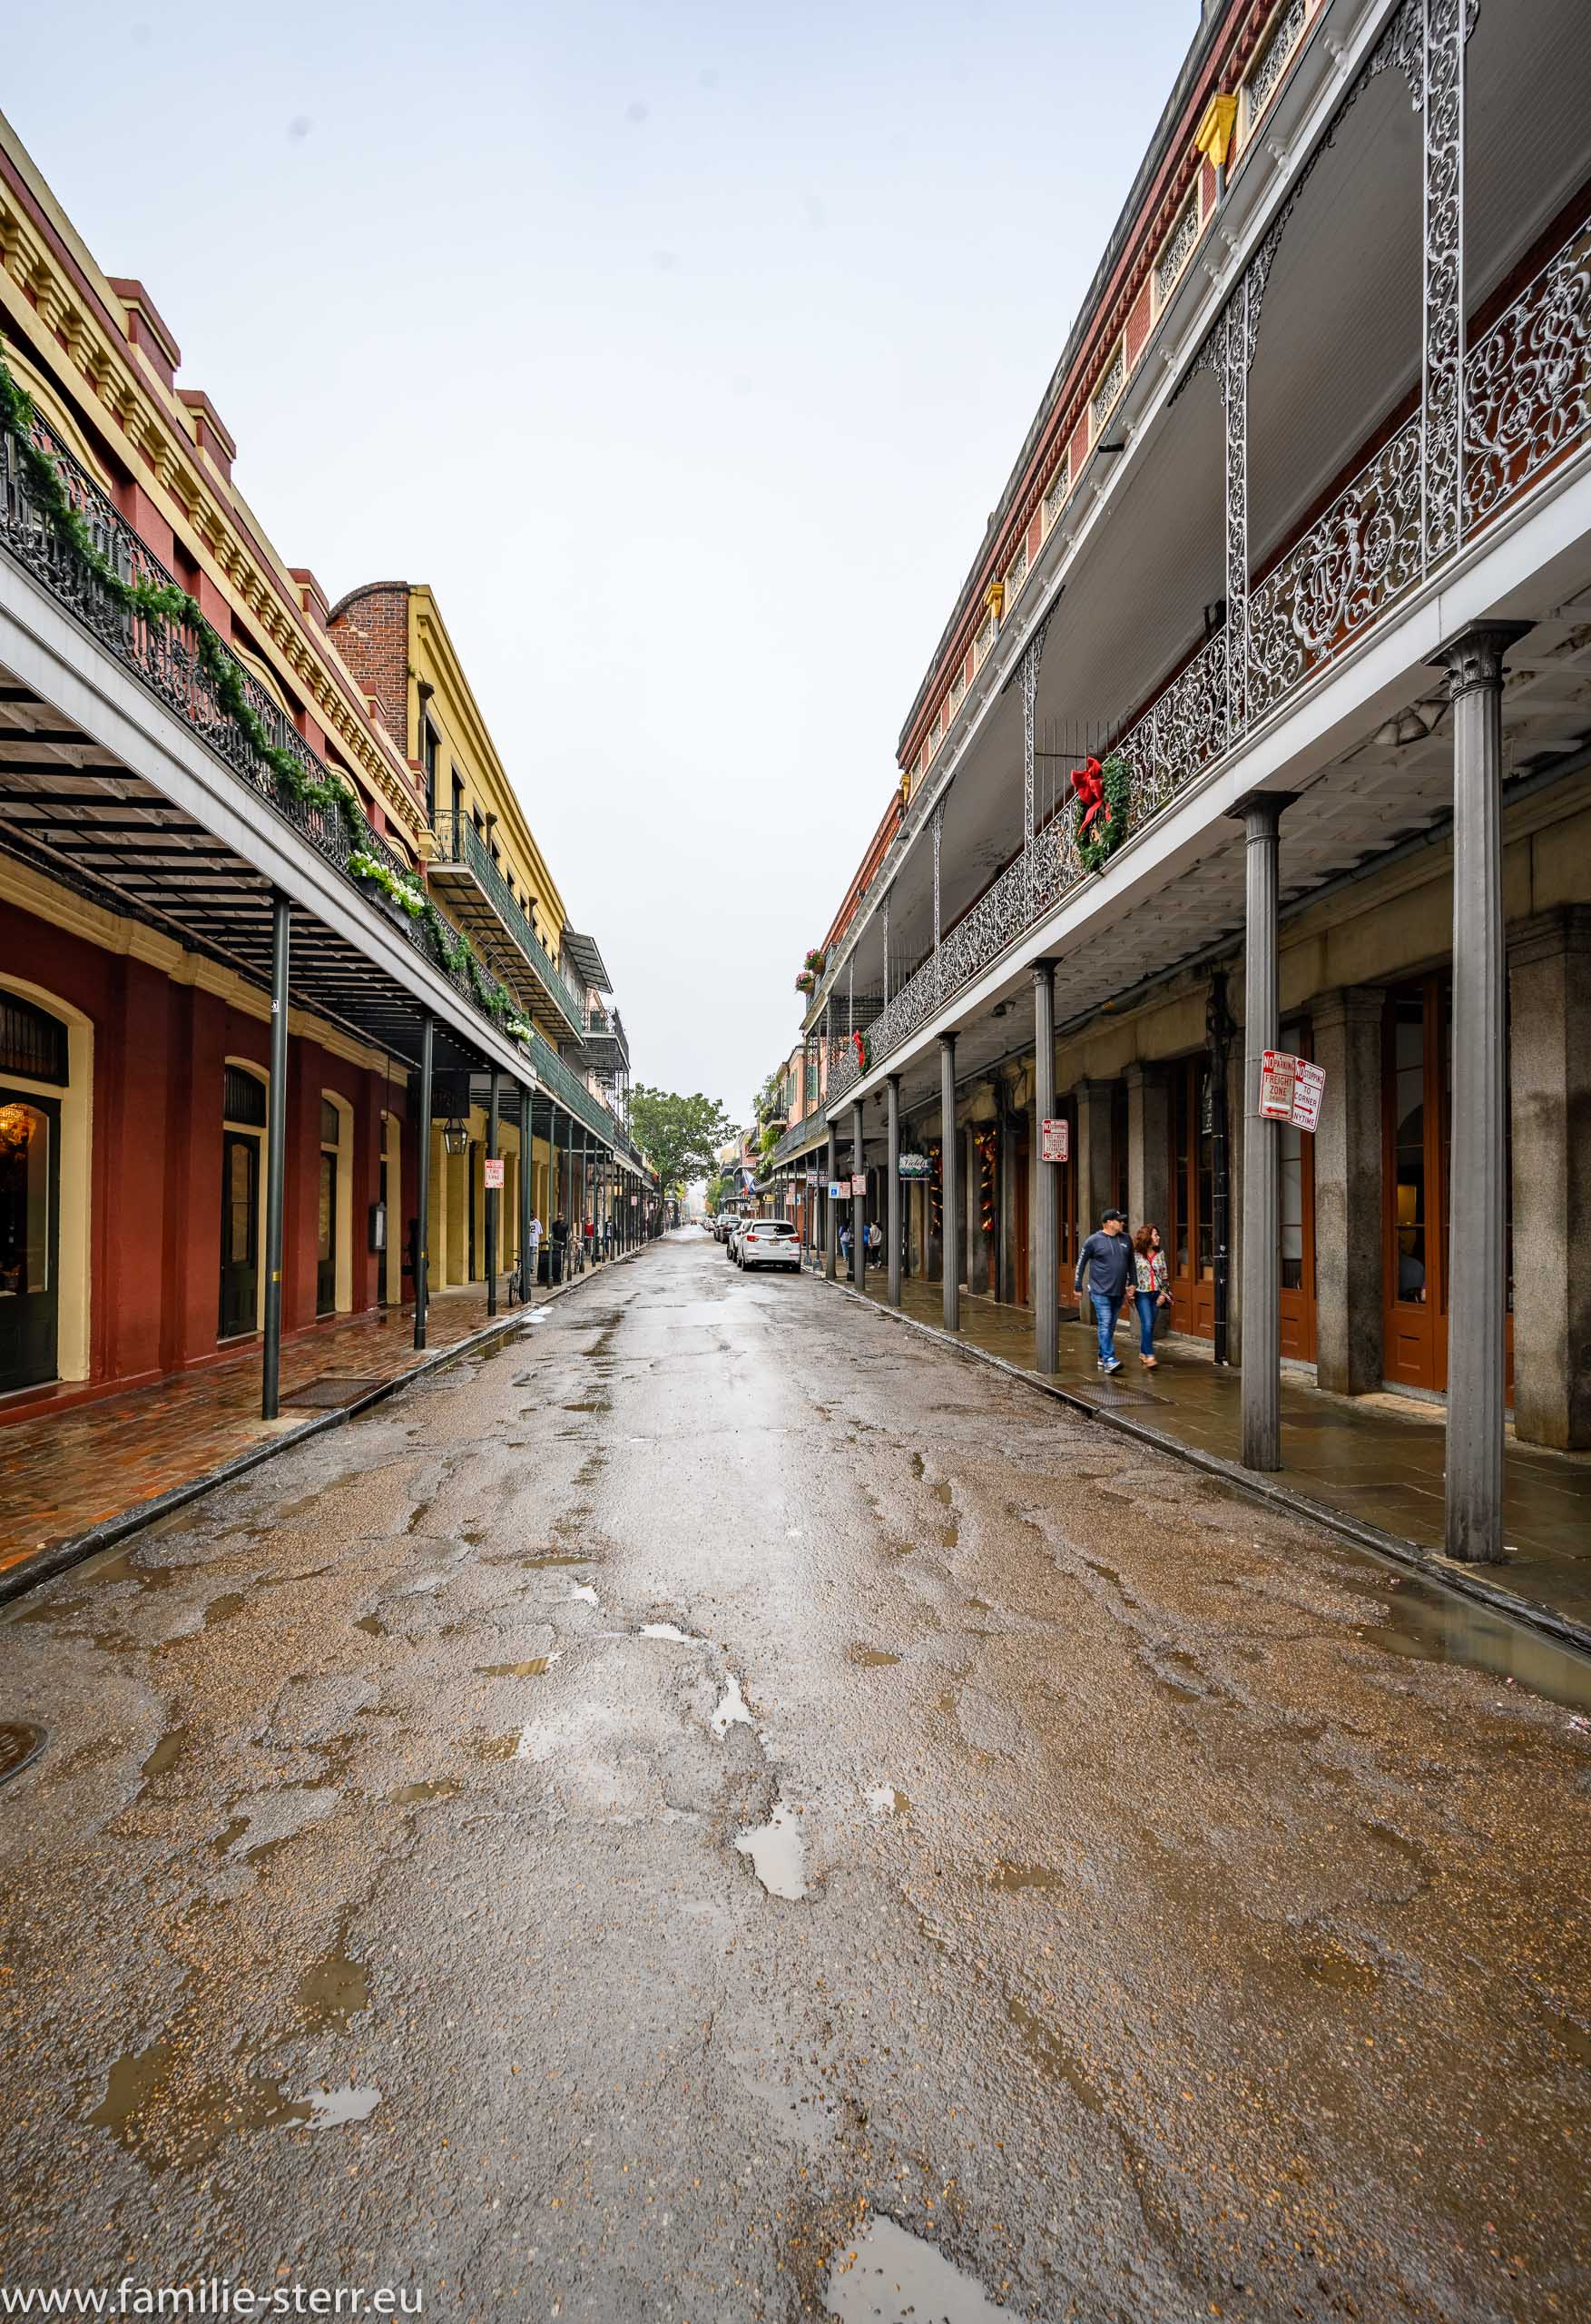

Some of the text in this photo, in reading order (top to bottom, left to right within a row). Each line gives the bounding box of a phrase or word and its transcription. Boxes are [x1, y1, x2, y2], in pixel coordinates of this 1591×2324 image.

[1263, 1055, 1294, 1070] NO PARKING
[1265, 1075, 1292, 1087] FREIGHT
[1296, 1065, 1323, 1085] NO STOPPING
[1270, 1085, 1287, 1097] ZONE
[1303, 1085, 1311, 1095] TO
[1295, 1091, 1317, 1108] CORNER
[1293, 1112, 1315, 1127] NYTIME
